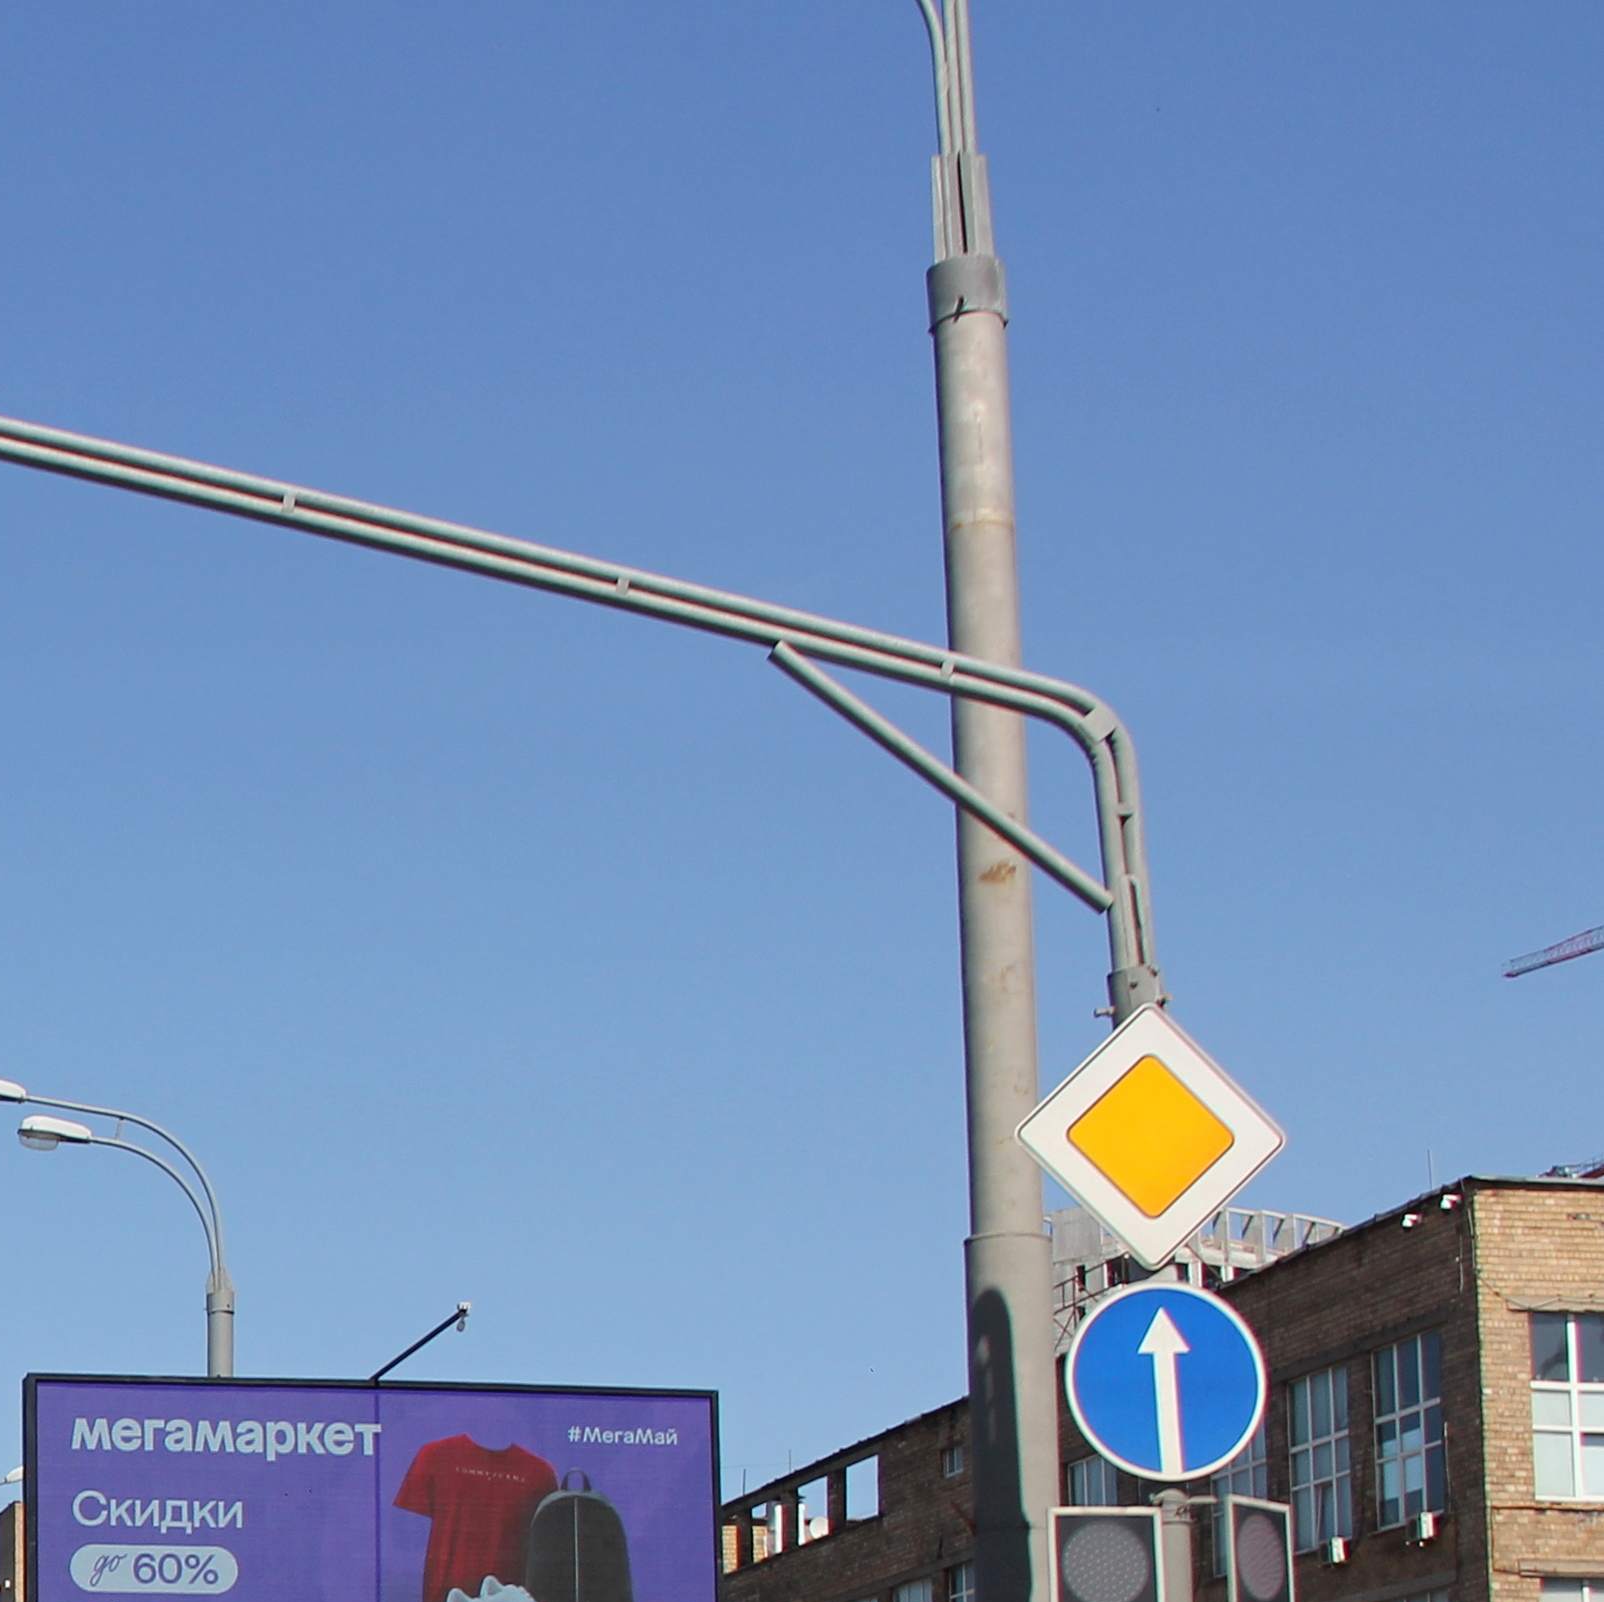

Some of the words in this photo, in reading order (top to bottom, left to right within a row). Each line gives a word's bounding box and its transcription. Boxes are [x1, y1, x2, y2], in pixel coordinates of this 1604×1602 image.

[71, 1418, 382, 1461] мегамаркет
[567, 1426, 678, 1445] #МегаМай
[72, 1490, 243, 1534] Скидки
[133, 1553, 219, 1585] 60%
